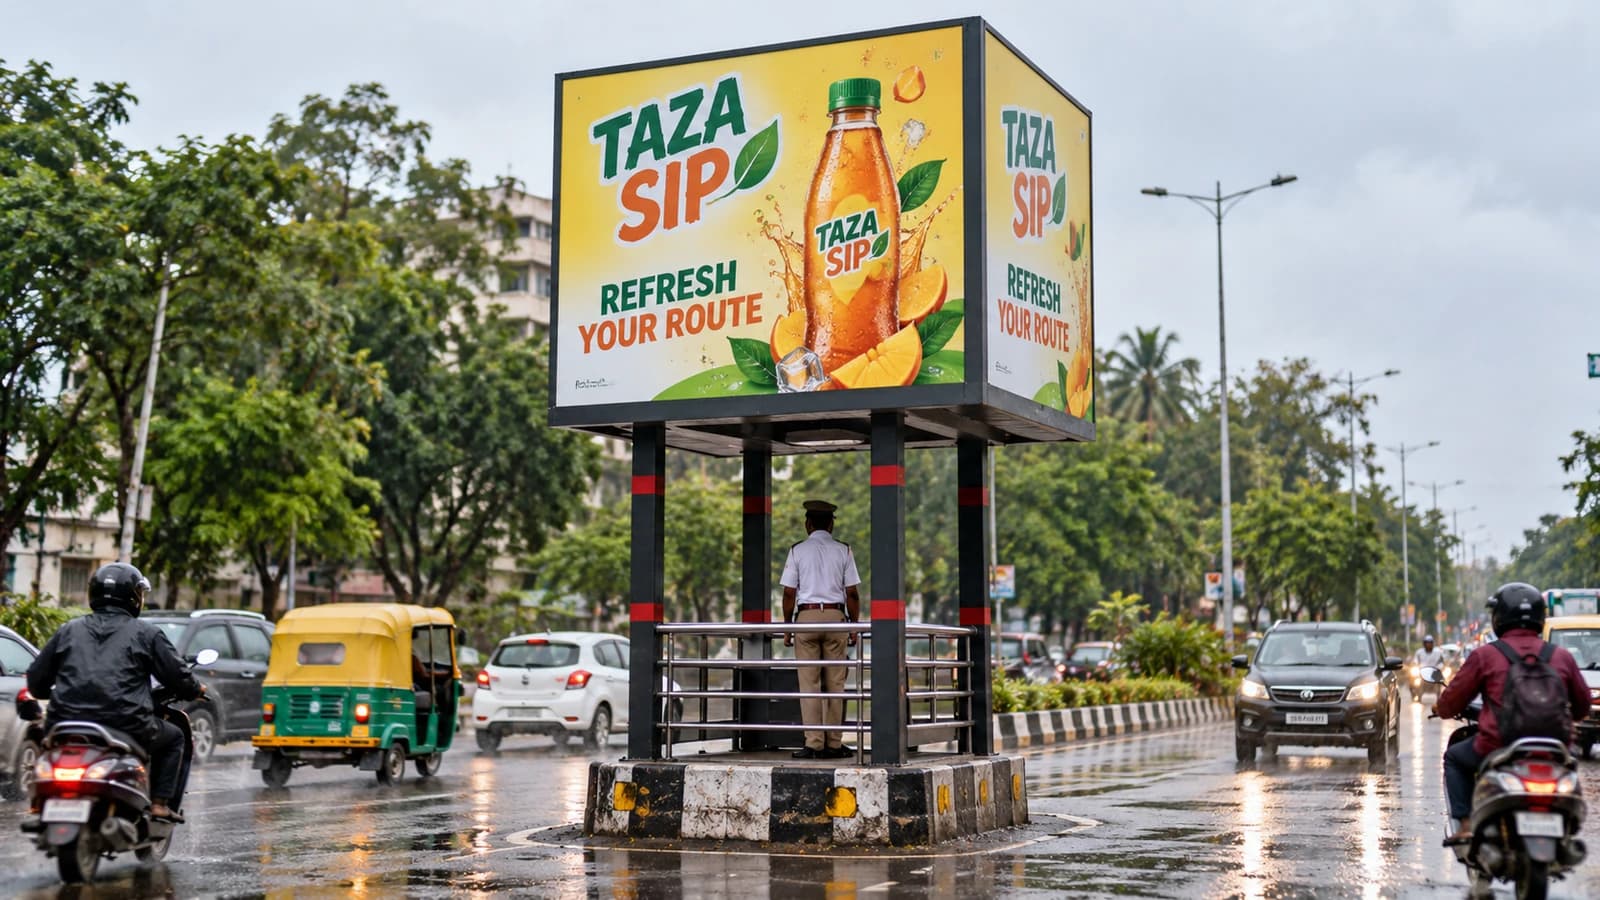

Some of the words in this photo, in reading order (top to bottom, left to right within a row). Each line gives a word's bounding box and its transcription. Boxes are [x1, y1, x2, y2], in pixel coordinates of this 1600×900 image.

[593, 77, 747, 180] TAZA
[1002, 110, 1056, 174] TAZA
[618, 147, 730, 242] SIP
[1013, 171, 1052, 239] SIP
[815, 210, 879, 252] TAZA
[826, 238, 871, 276] SIP
[600, 260, 737, 316] REFRESH
[1007, 262, 1061, 315] REFRESH
[578, 312, 657, 355] YOUR
[665, 292, 763, 340] ROUTE
[998, 298, 1031, 342] YOUR
[1034, 311, 1070, 353] ROUTE
